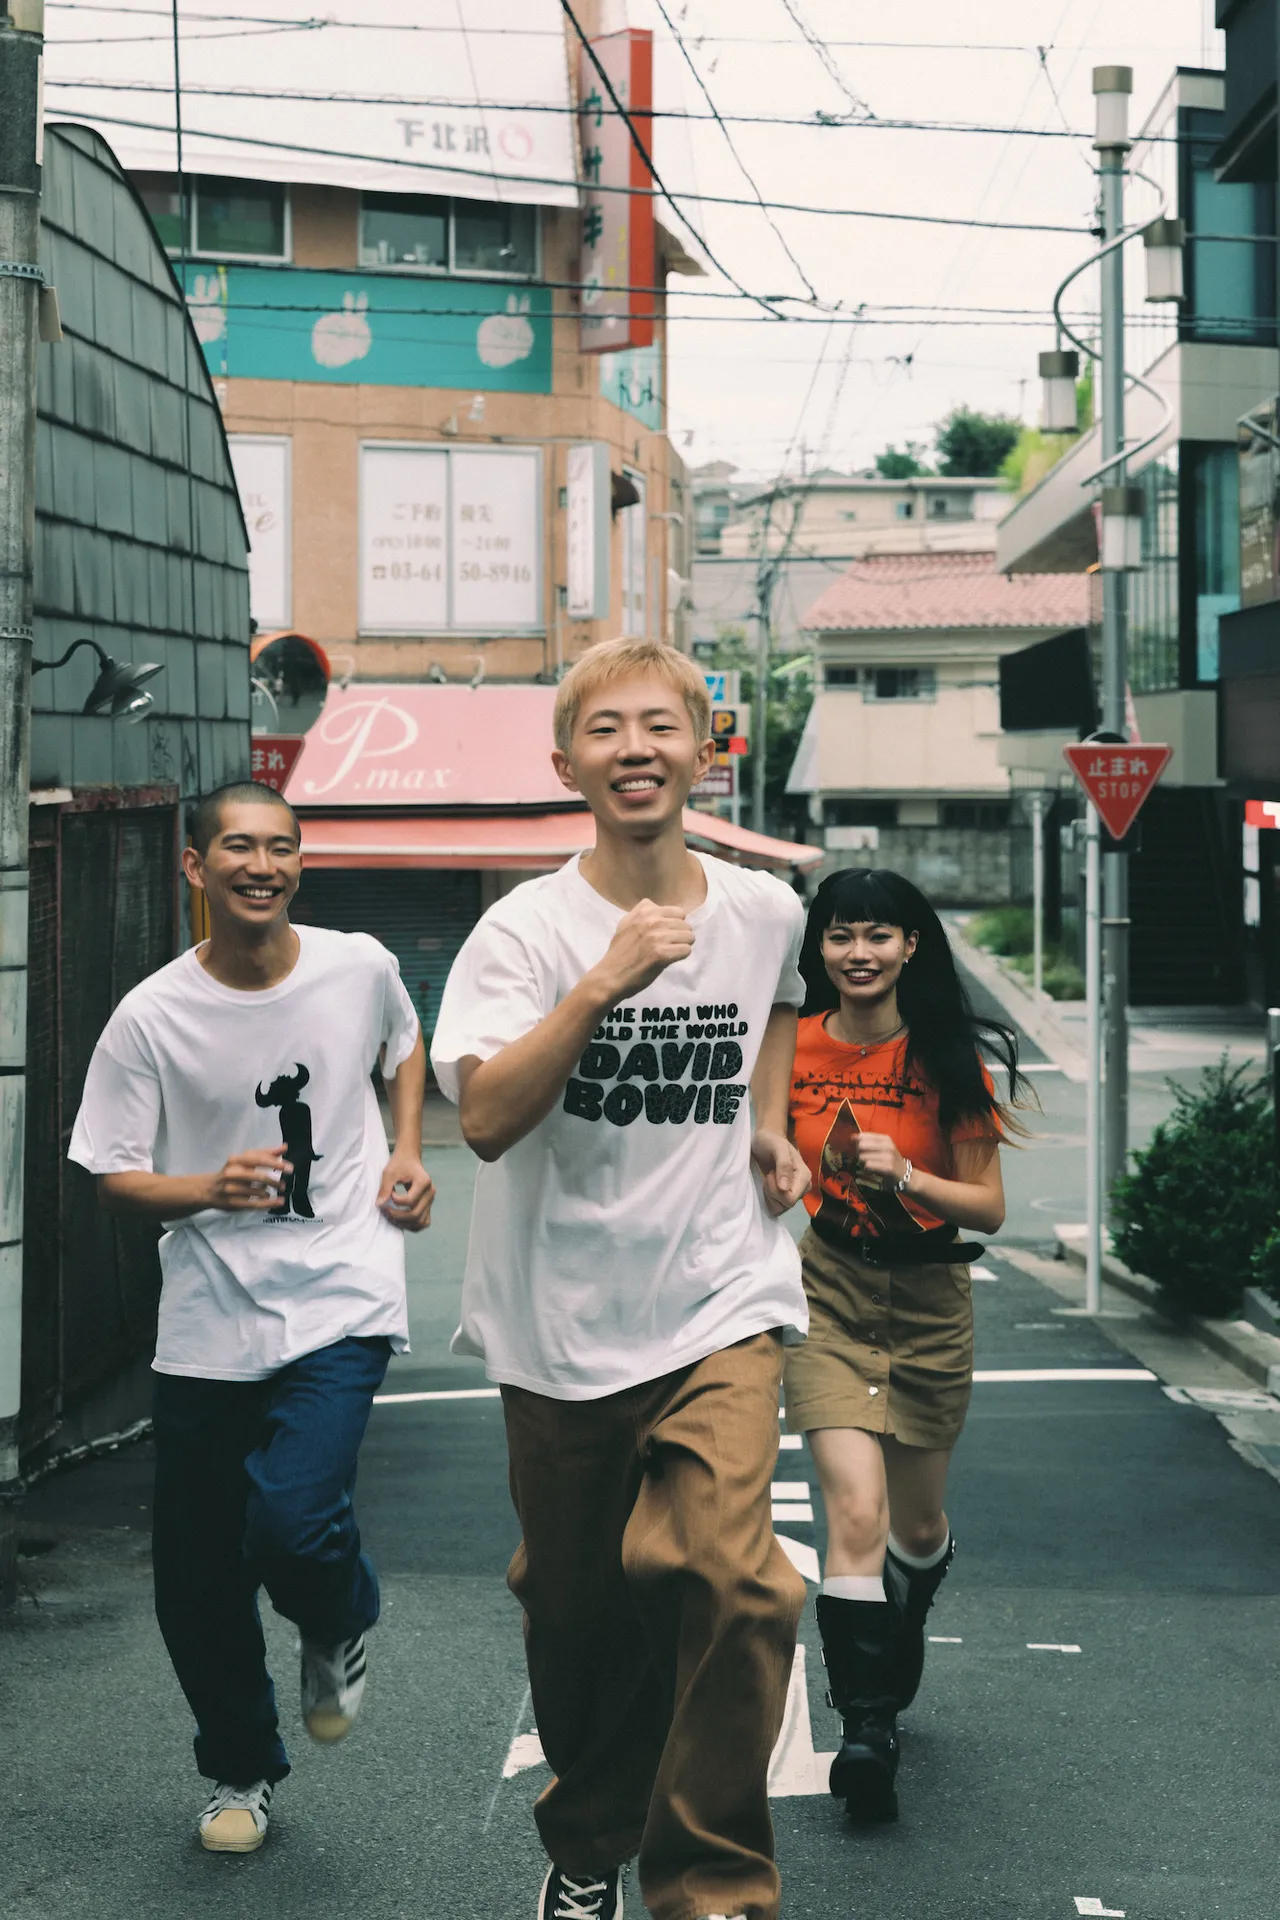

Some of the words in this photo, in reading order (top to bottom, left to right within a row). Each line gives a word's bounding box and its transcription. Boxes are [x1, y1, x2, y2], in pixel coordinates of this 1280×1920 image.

[396, 118, 491, 156] 下北沢
[252, 749, 286, 772] まれ
[1087, 756, 1149, 777] 止まれ
[1098, 782, 1141, 798] STOP
[606, 1007, 636, 1023] HE
[641, 1006, 690, 1022] MAN
[696, 1003, 738, 1020] WHO
[592, 1025, 633, 1041] OLD
[638, 1025, 679, 1040] THE
[686, 1022, 748, 1039] WORLD
[579, 1041, 743, 1081] DAVID
[563, 1077, 747, 1127] BOWIE
